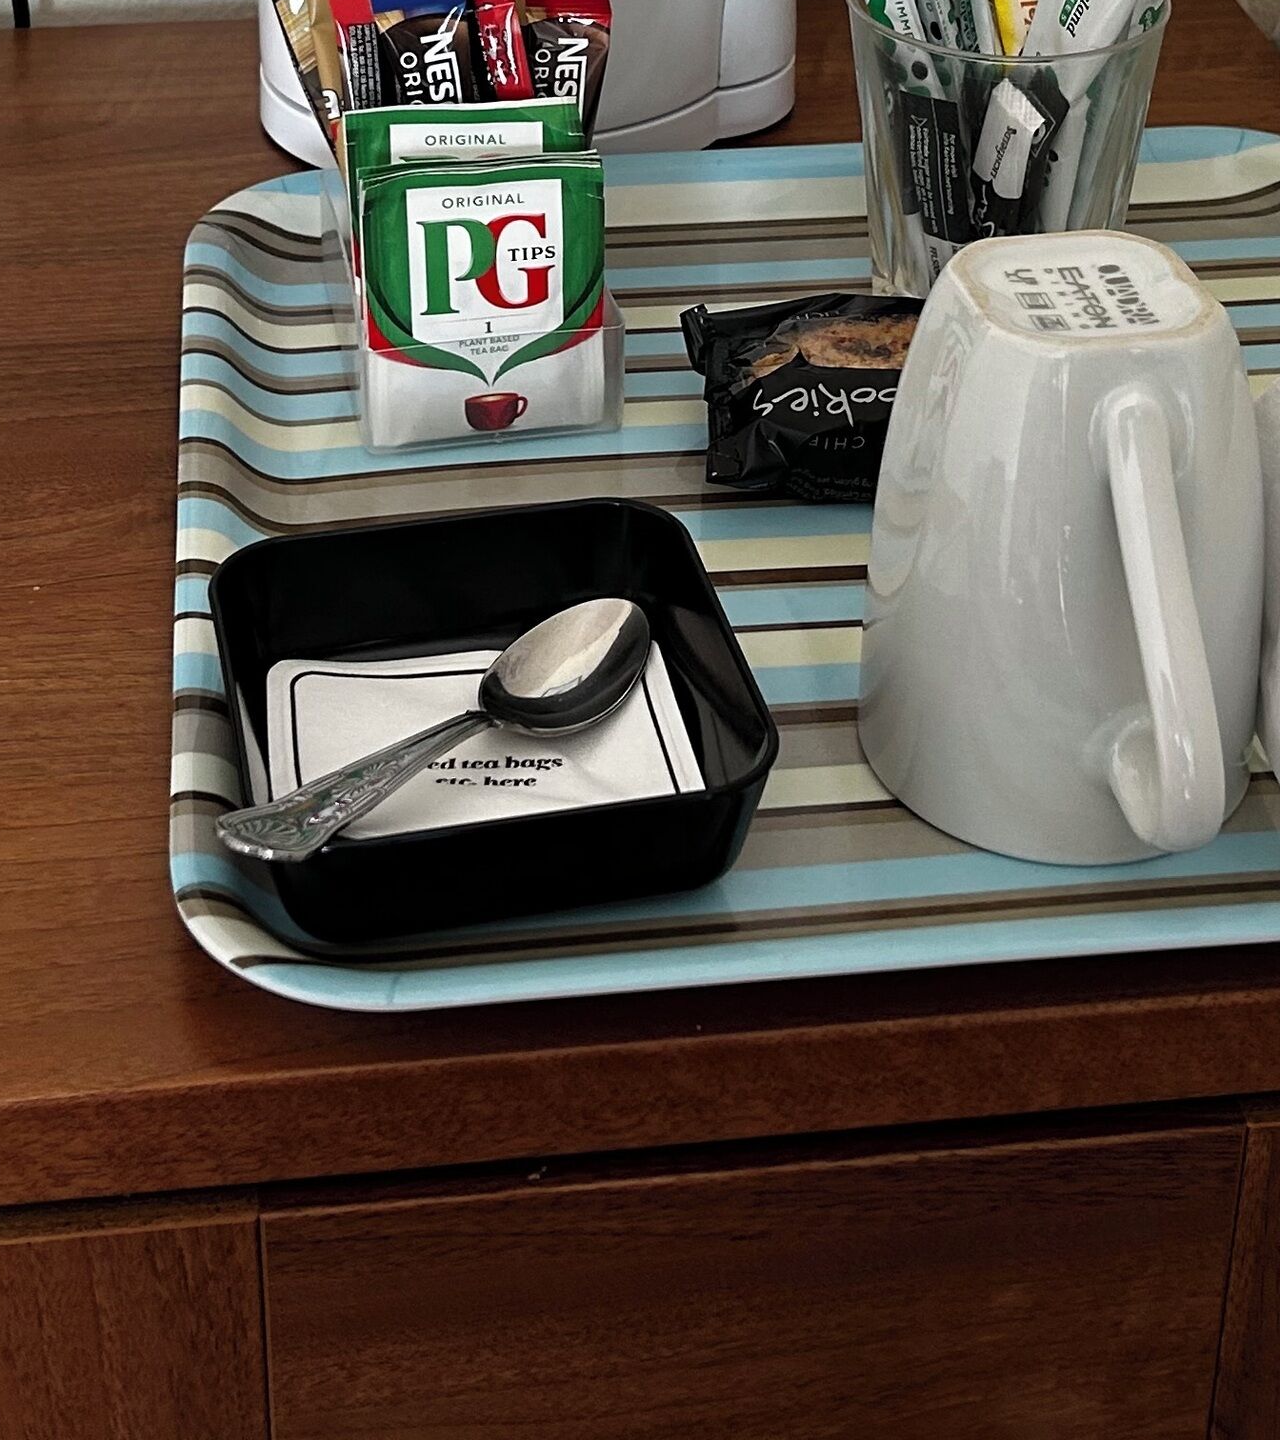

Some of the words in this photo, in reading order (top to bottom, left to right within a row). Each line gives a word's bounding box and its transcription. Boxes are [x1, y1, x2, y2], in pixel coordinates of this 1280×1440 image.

[424, 133, 507, 147] ORIGINAL
[441, 192, 525, 209] ORIGINAL
[507, 245, 557, 263] TIPS
[416, 212, 556, 317] PG
[1056, 266, 1118, 329] EATON
[484, 321, 493, 334] 1
[458, 337, 488, 348] PLANT
[490, 334, 520, 344] BASED
[470, 347, 488, 356] TEA
[752, 382, 898, 428] ookies
[461, 759, 500, 769] tea
[505, 755, 564, 771] bags
[483, 776, 537, 787] here
